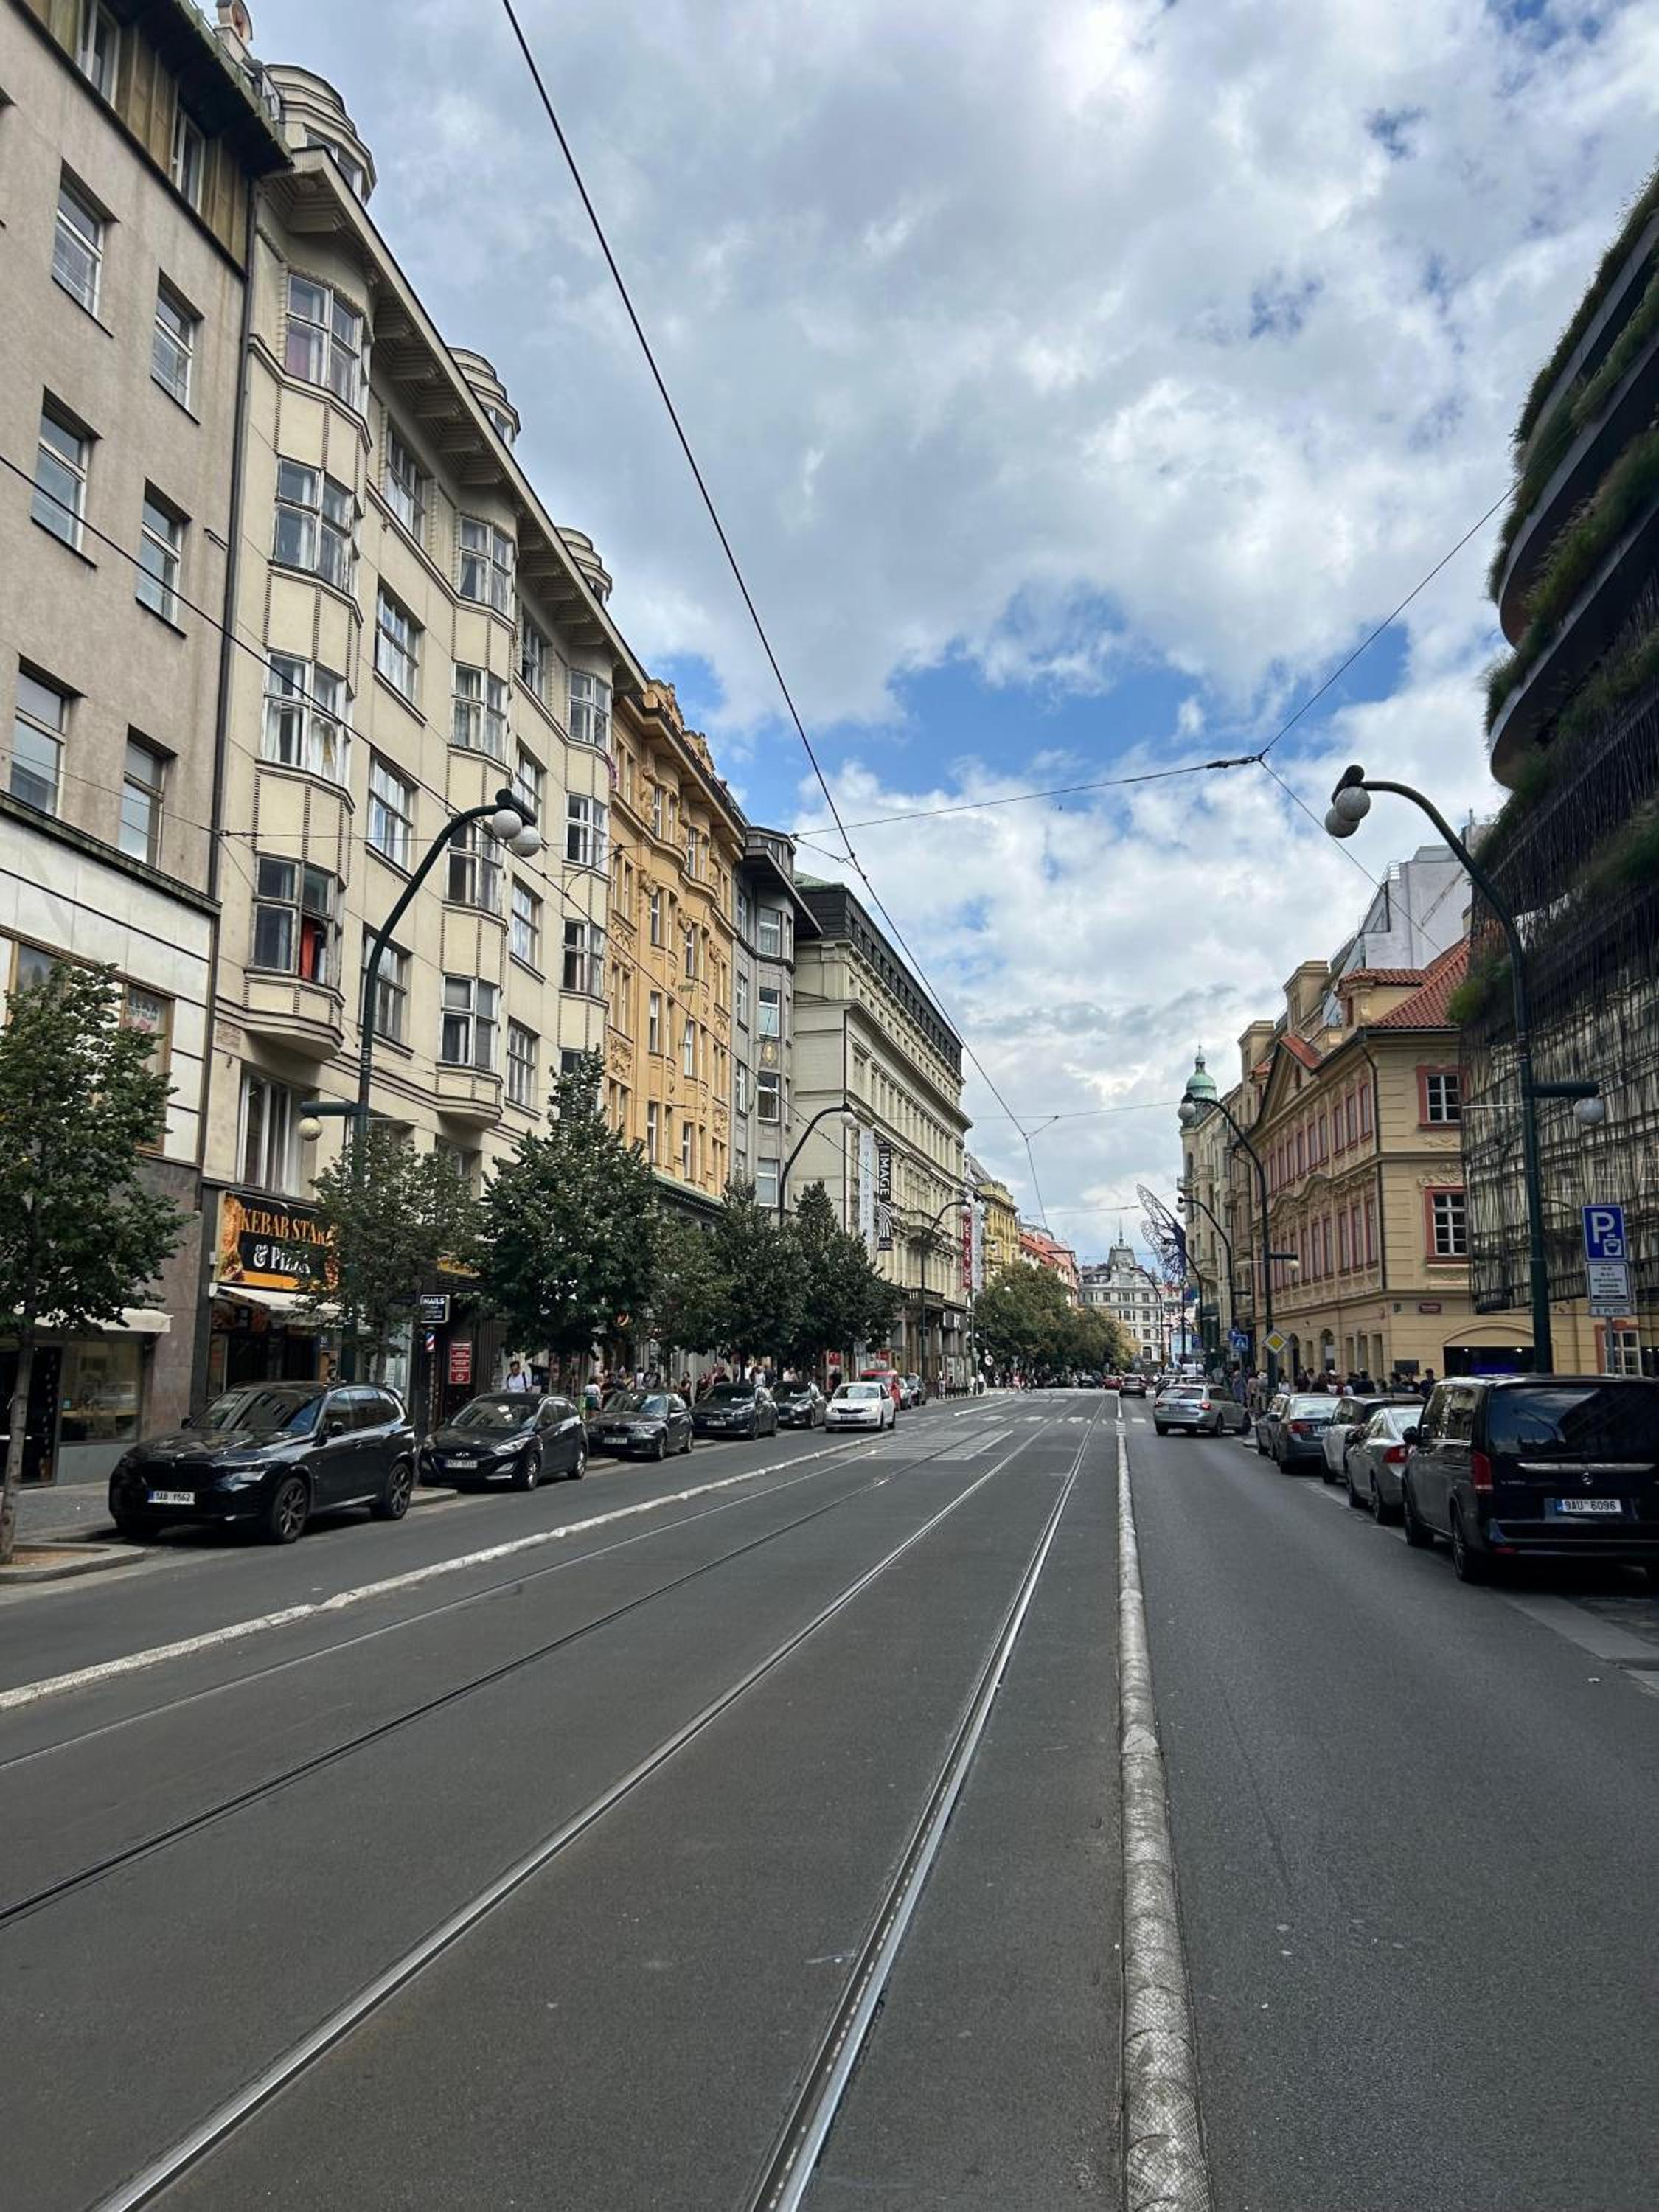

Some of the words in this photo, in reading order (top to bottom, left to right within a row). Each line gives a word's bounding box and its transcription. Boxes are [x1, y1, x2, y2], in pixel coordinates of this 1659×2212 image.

[880, 1153, 890, 1195] IMAGE
[240, 1208, 290, 1239] KEBAB
[1590, 1211, 1615, 1244] P
[253, 1244, 269, 1267] &
[1590, 1500, 1617, 1510] 6096
